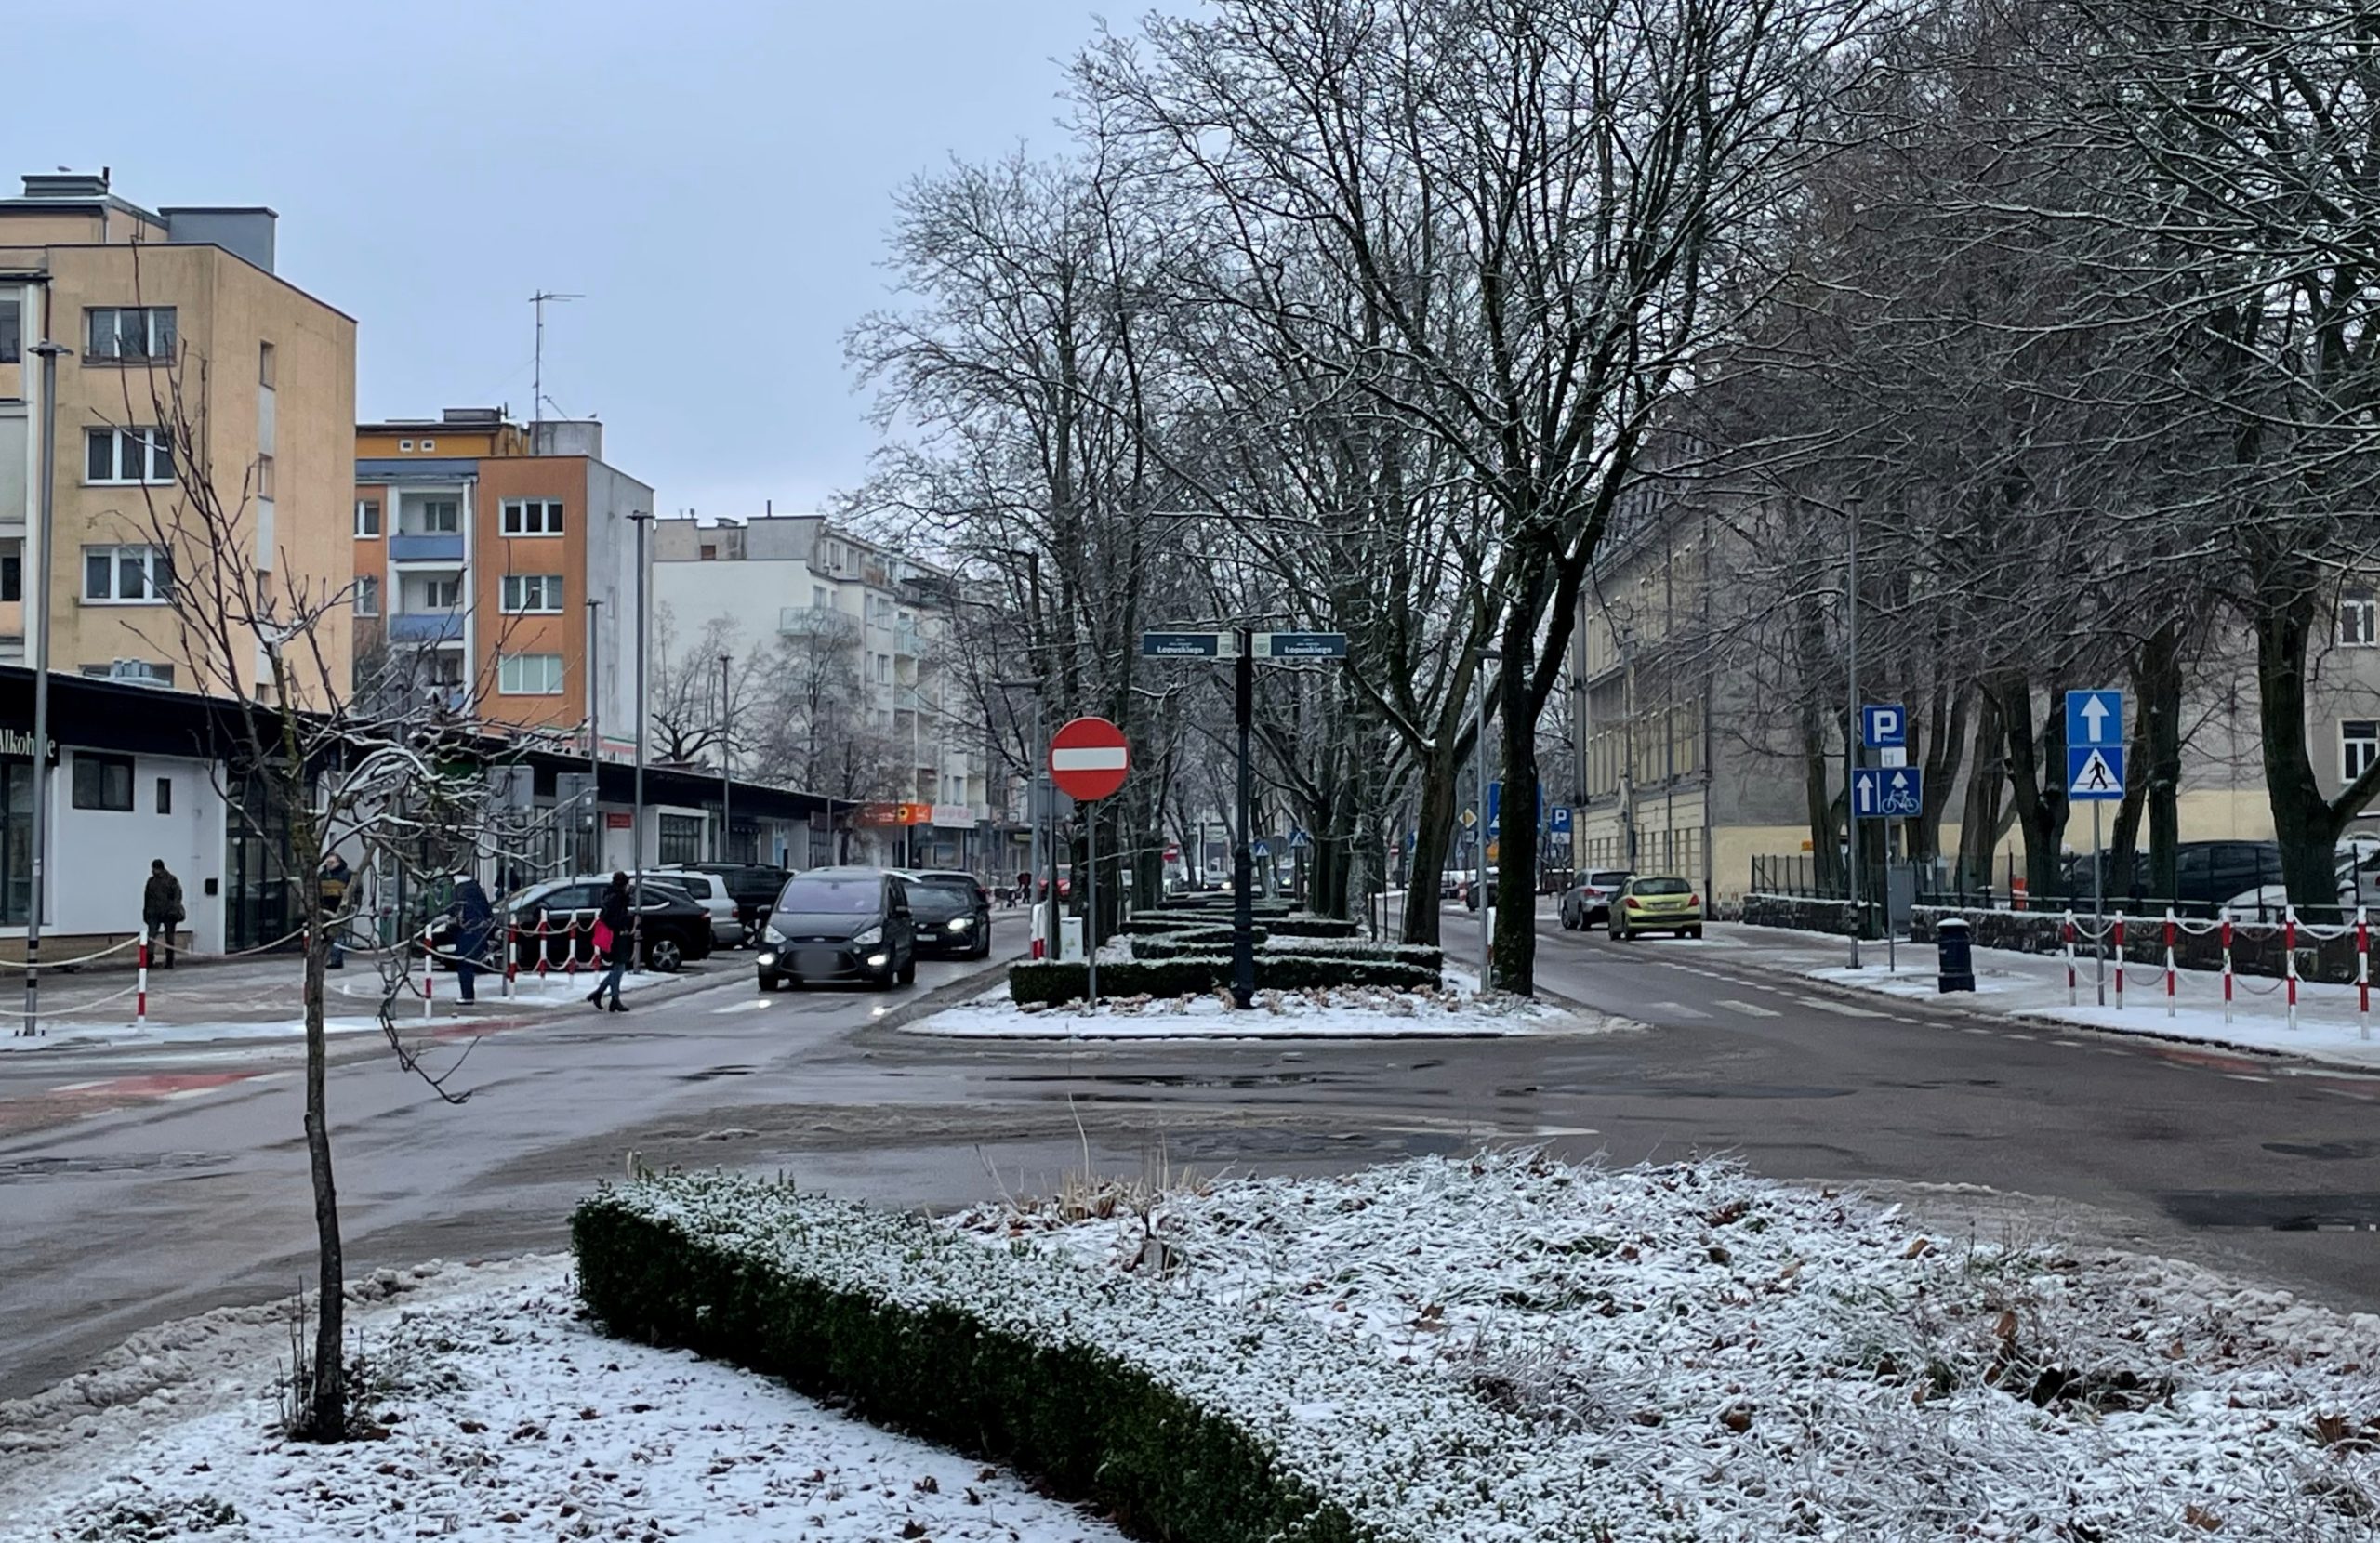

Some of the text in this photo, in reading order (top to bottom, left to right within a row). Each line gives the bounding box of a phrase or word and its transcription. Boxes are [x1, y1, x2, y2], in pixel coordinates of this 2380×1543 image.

[1157, 645, 1205, 655] Łopuskiego
[1284, 645, 1333, 655] Łopuskiego
[1873, 710, 1897, 743] P
[1554, 809, 1567, 824] P
